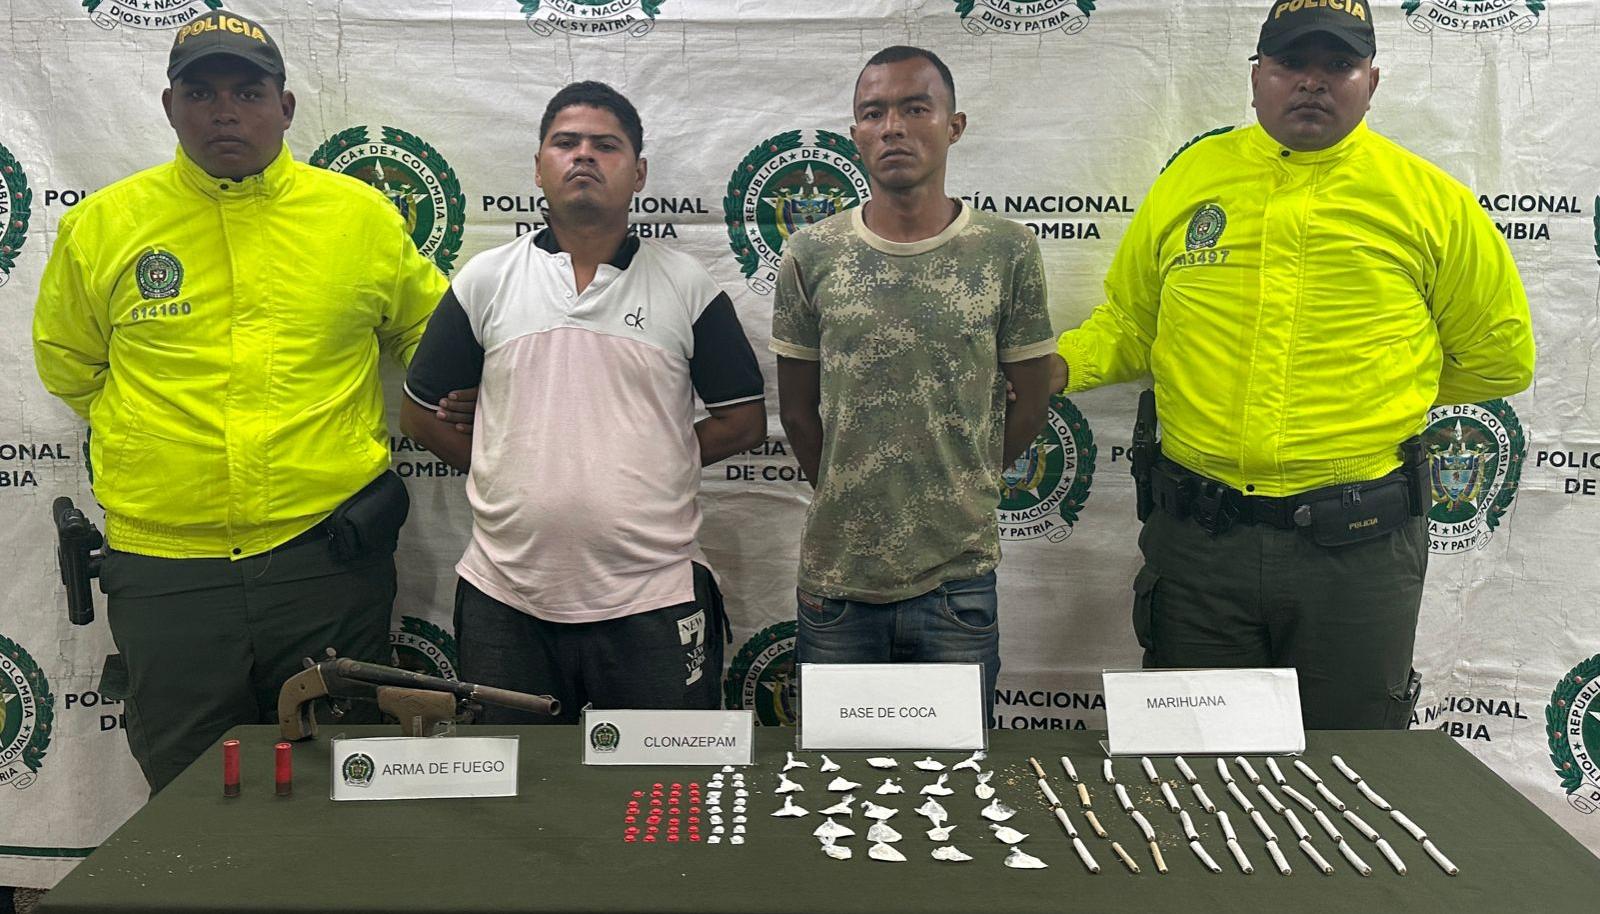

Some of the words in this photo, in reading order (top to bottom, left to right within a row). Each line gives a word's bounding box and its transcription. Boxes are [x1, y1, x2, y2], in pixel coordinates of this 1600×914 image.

[154, 7, 199, 27] PATRIA
[591, 14, 635, 33] PATRIA
[1025, 11, 1070, 31] PATRIA
[1472, 10, 1519, 30] PATRIA
[178, 15, 268, 45] POLICIA
[369, 145, 388, 155] DE
[401, 153, 446, 220] COLOMBIA
[745, 156, 788, 222] REPUBLICA
[801, 149, 820, 159] DE
[1004, 195, 1135, 213] NACIONAL
[131, 301, 192, 320] 614160
[1452, 405, 1470, 415] DE
[1480, 412, 1510, 477] COLOMBIA
[726, 465, 755, 481] DE
[1564, 478, 1597, 496] DE
[1011, 483, 1069, 522] NACIONAL
[1452, 491, 1500, 535] NACIONAL
[1010, 519, 1054, 537] PATRIA
[744, 643, 786, 706] REPUBLICA
[1146, 695, 1227, 709] MARIHUANA
[839, 707, 876, 719] BASE
[877, 707, 897, 719] DE
[898, 706, 937, 719] COCA
[643, 736, 737, 749] CLONAZEPAM
[382, 763, 425, 776] ARMA
[428, 762, 449, 775] DE
[453, 760, 505, 774] FUEGO
